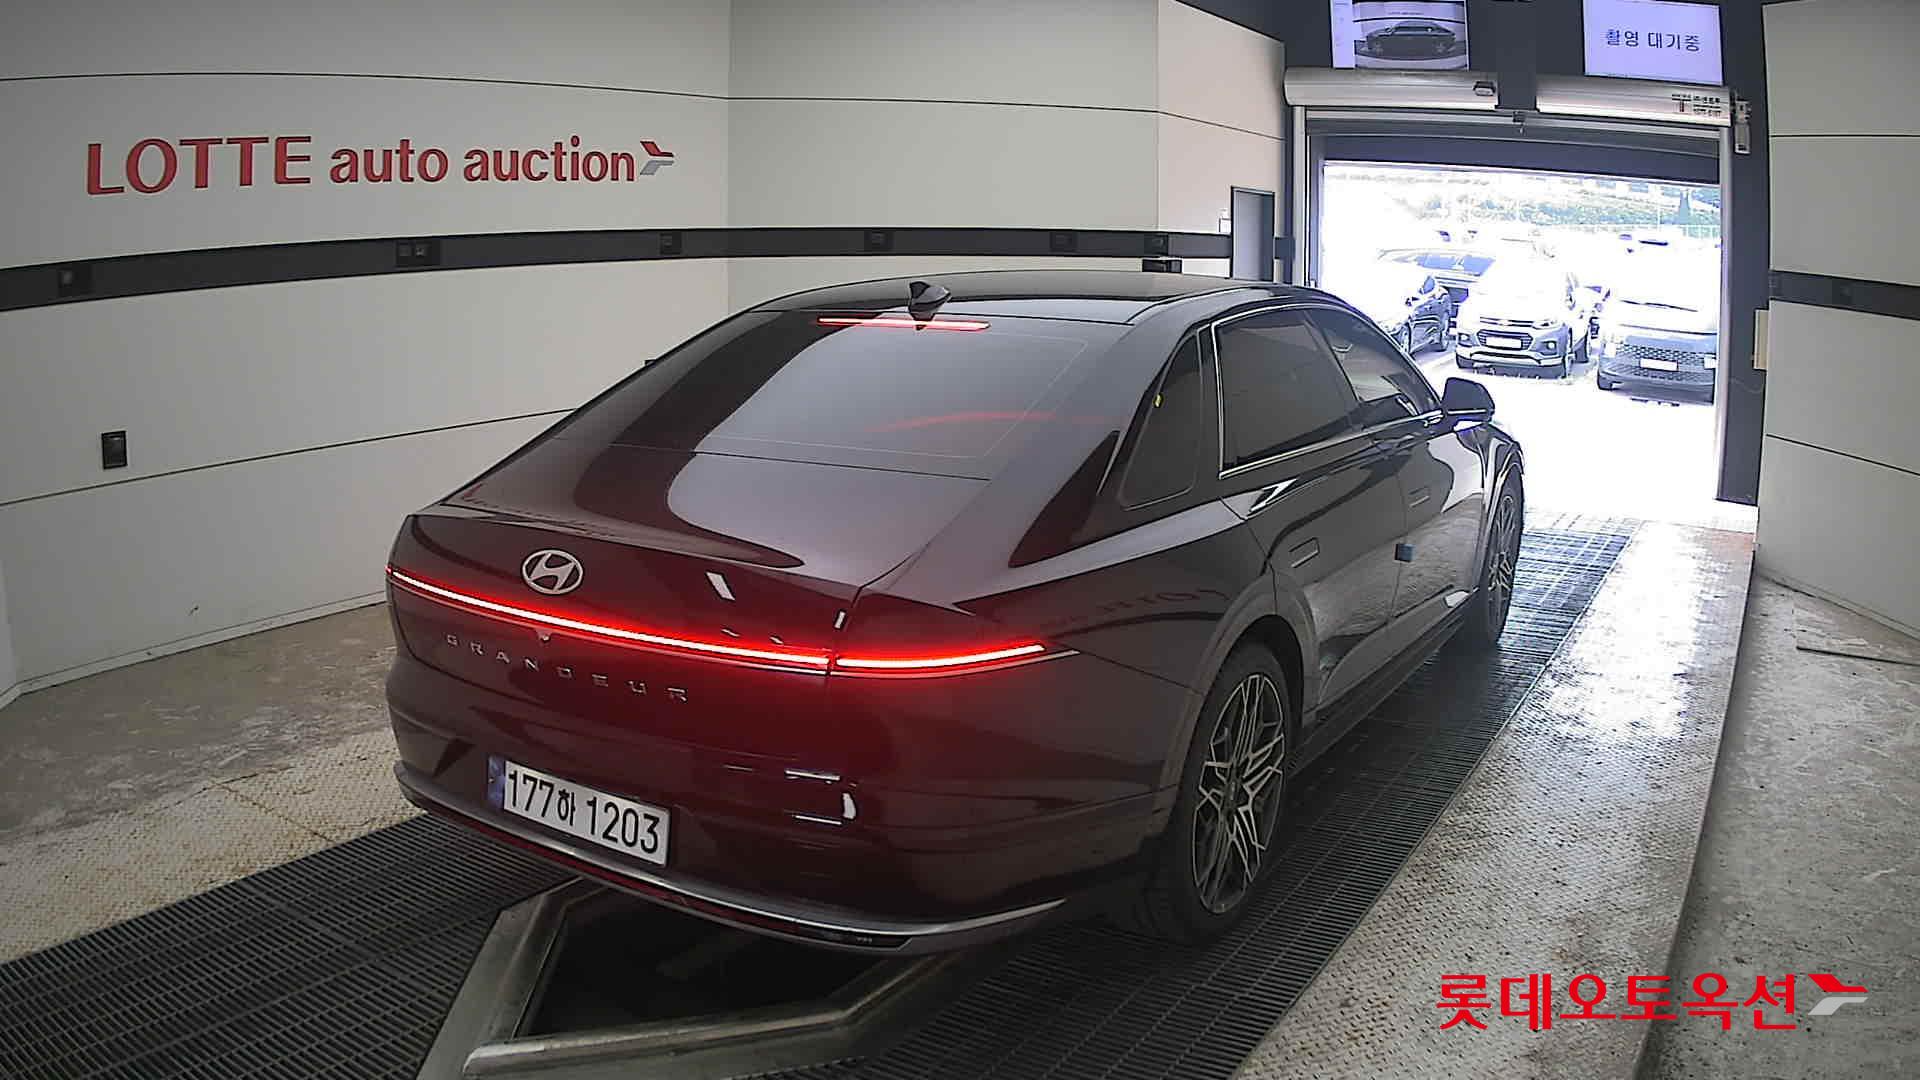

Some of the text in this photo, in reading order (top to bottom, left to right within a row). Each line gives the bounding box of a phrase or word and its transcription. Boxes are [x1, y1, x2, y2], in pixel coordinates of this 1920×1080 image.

[1646, 31, 1701, 53] 대기중
[86, 135, 636, 197] LOTTE auto auction
[446, 634, 689, 702] GRANDEUR
[508, 769, 661, 854] 177하 1203
